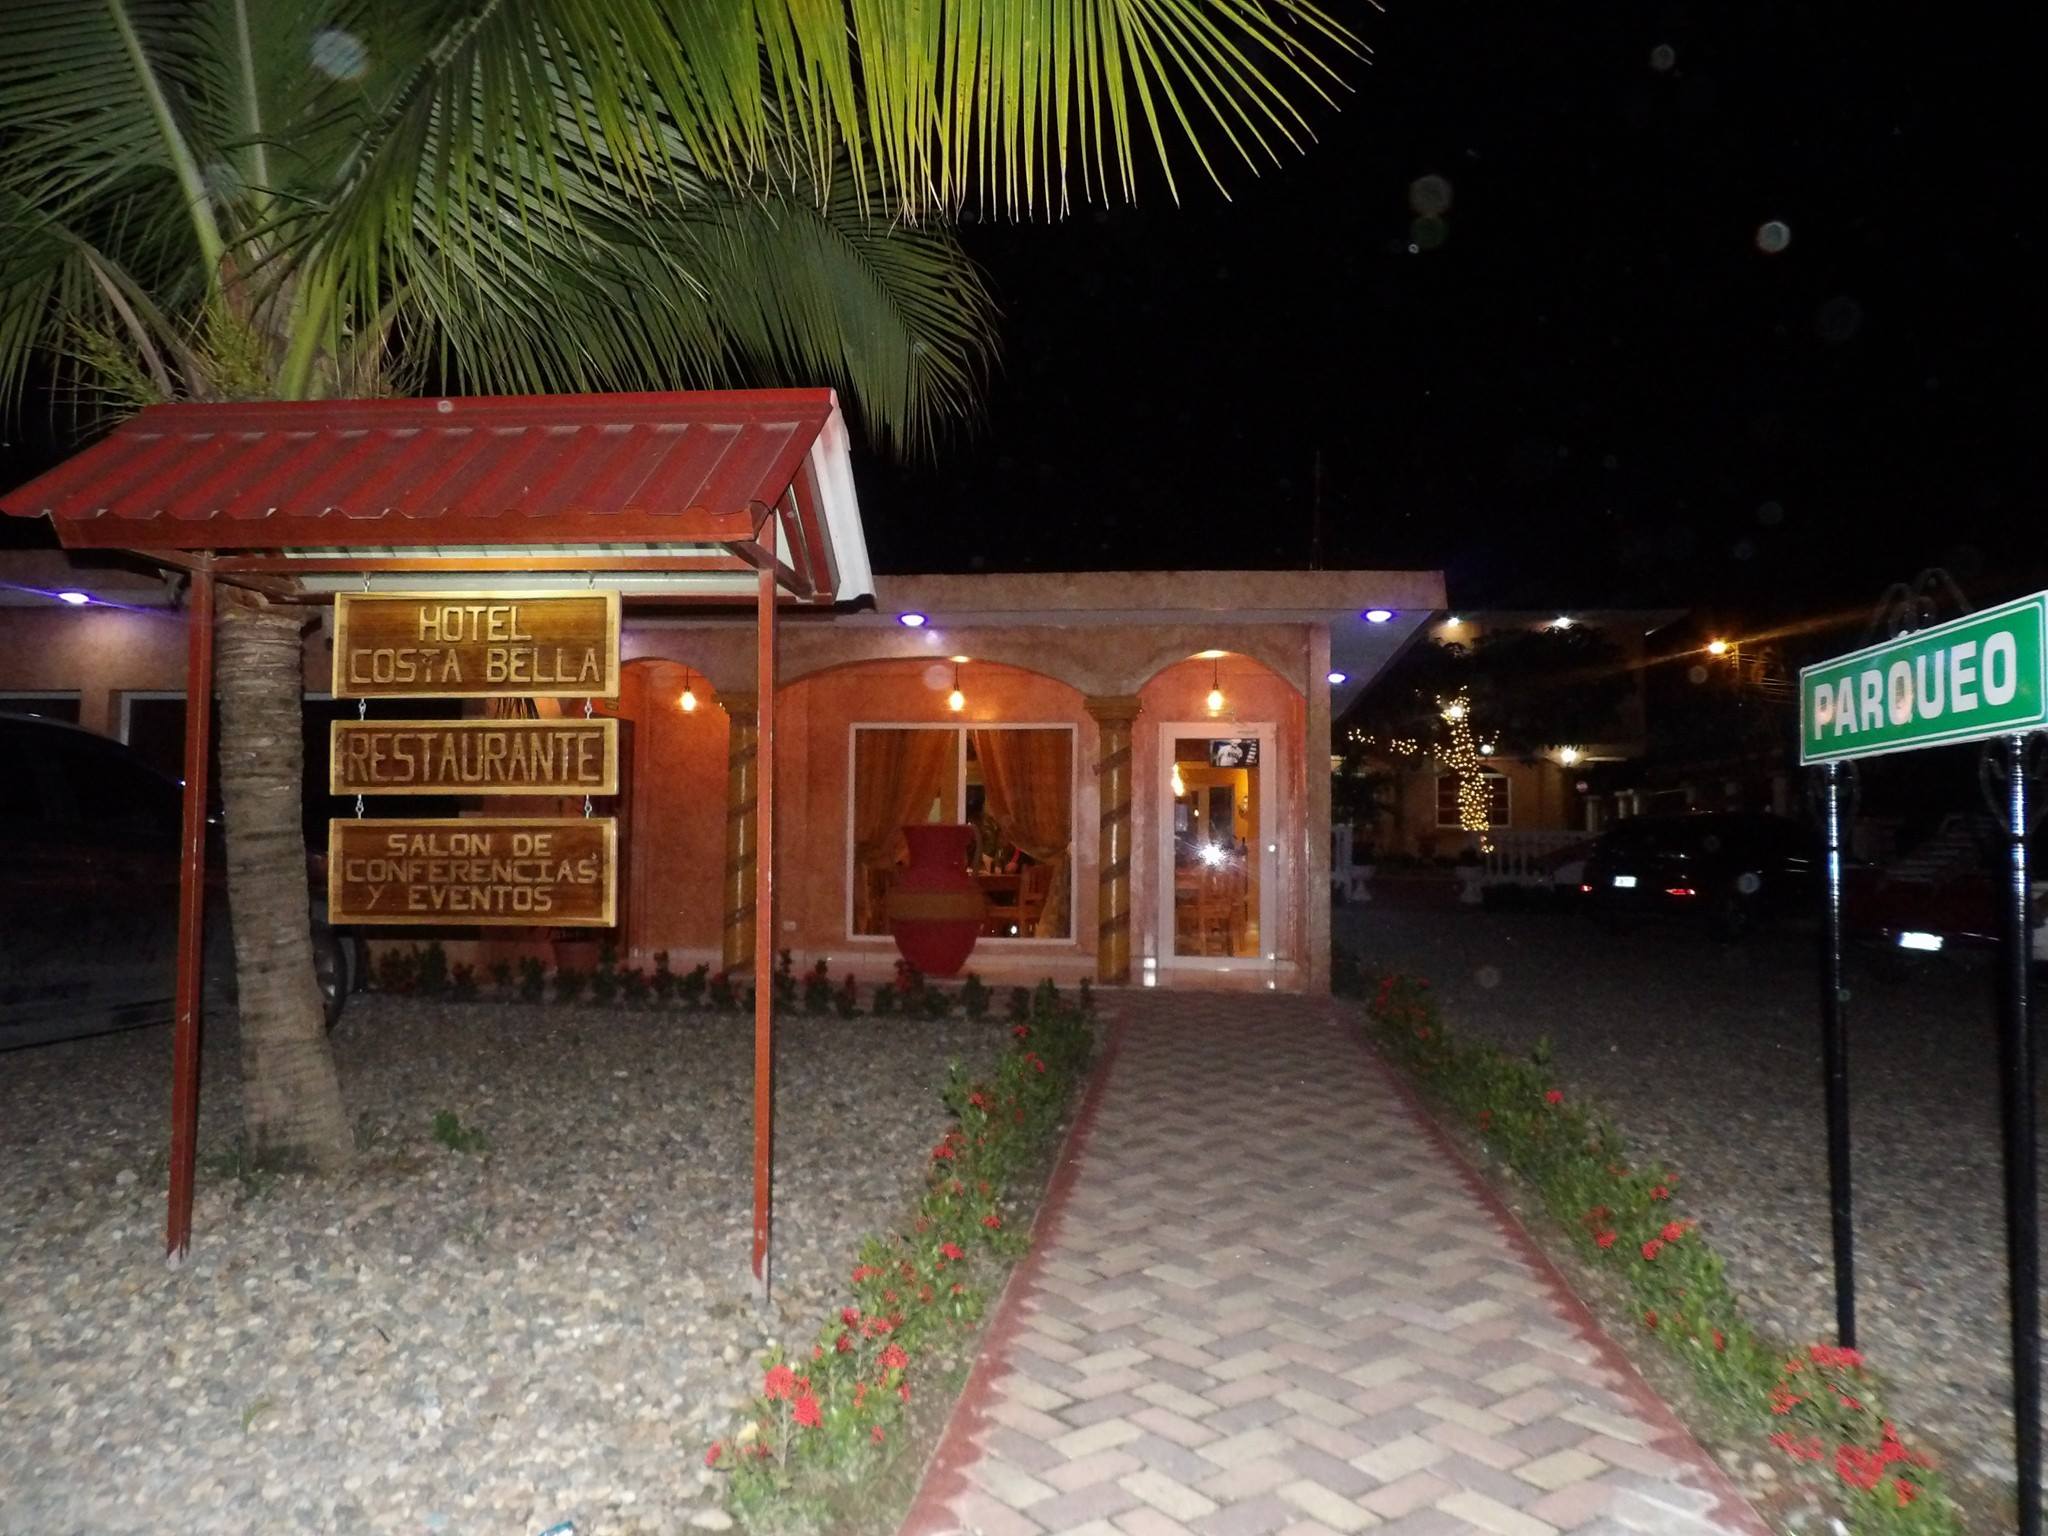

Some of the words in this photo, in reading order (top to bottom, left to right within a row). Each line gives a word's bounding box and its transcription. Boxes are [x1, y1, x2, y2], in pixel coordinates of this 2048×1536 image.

[419, 606, 532, 641] HOTEL
[350, 649, 463, 684] COSTA
[486, 648, 600, 683] BELLA
[1814, 631, 2017, 740] PARQUEO
[347, 732, 600, 782] RESTAURANTE
[387, 834, 491, 857] SALON
[513, 834, 552, 857] DE
[346, 859, 598, 884] CONFERENCIAS
[408, 885, 552, 911] EVENTOS
